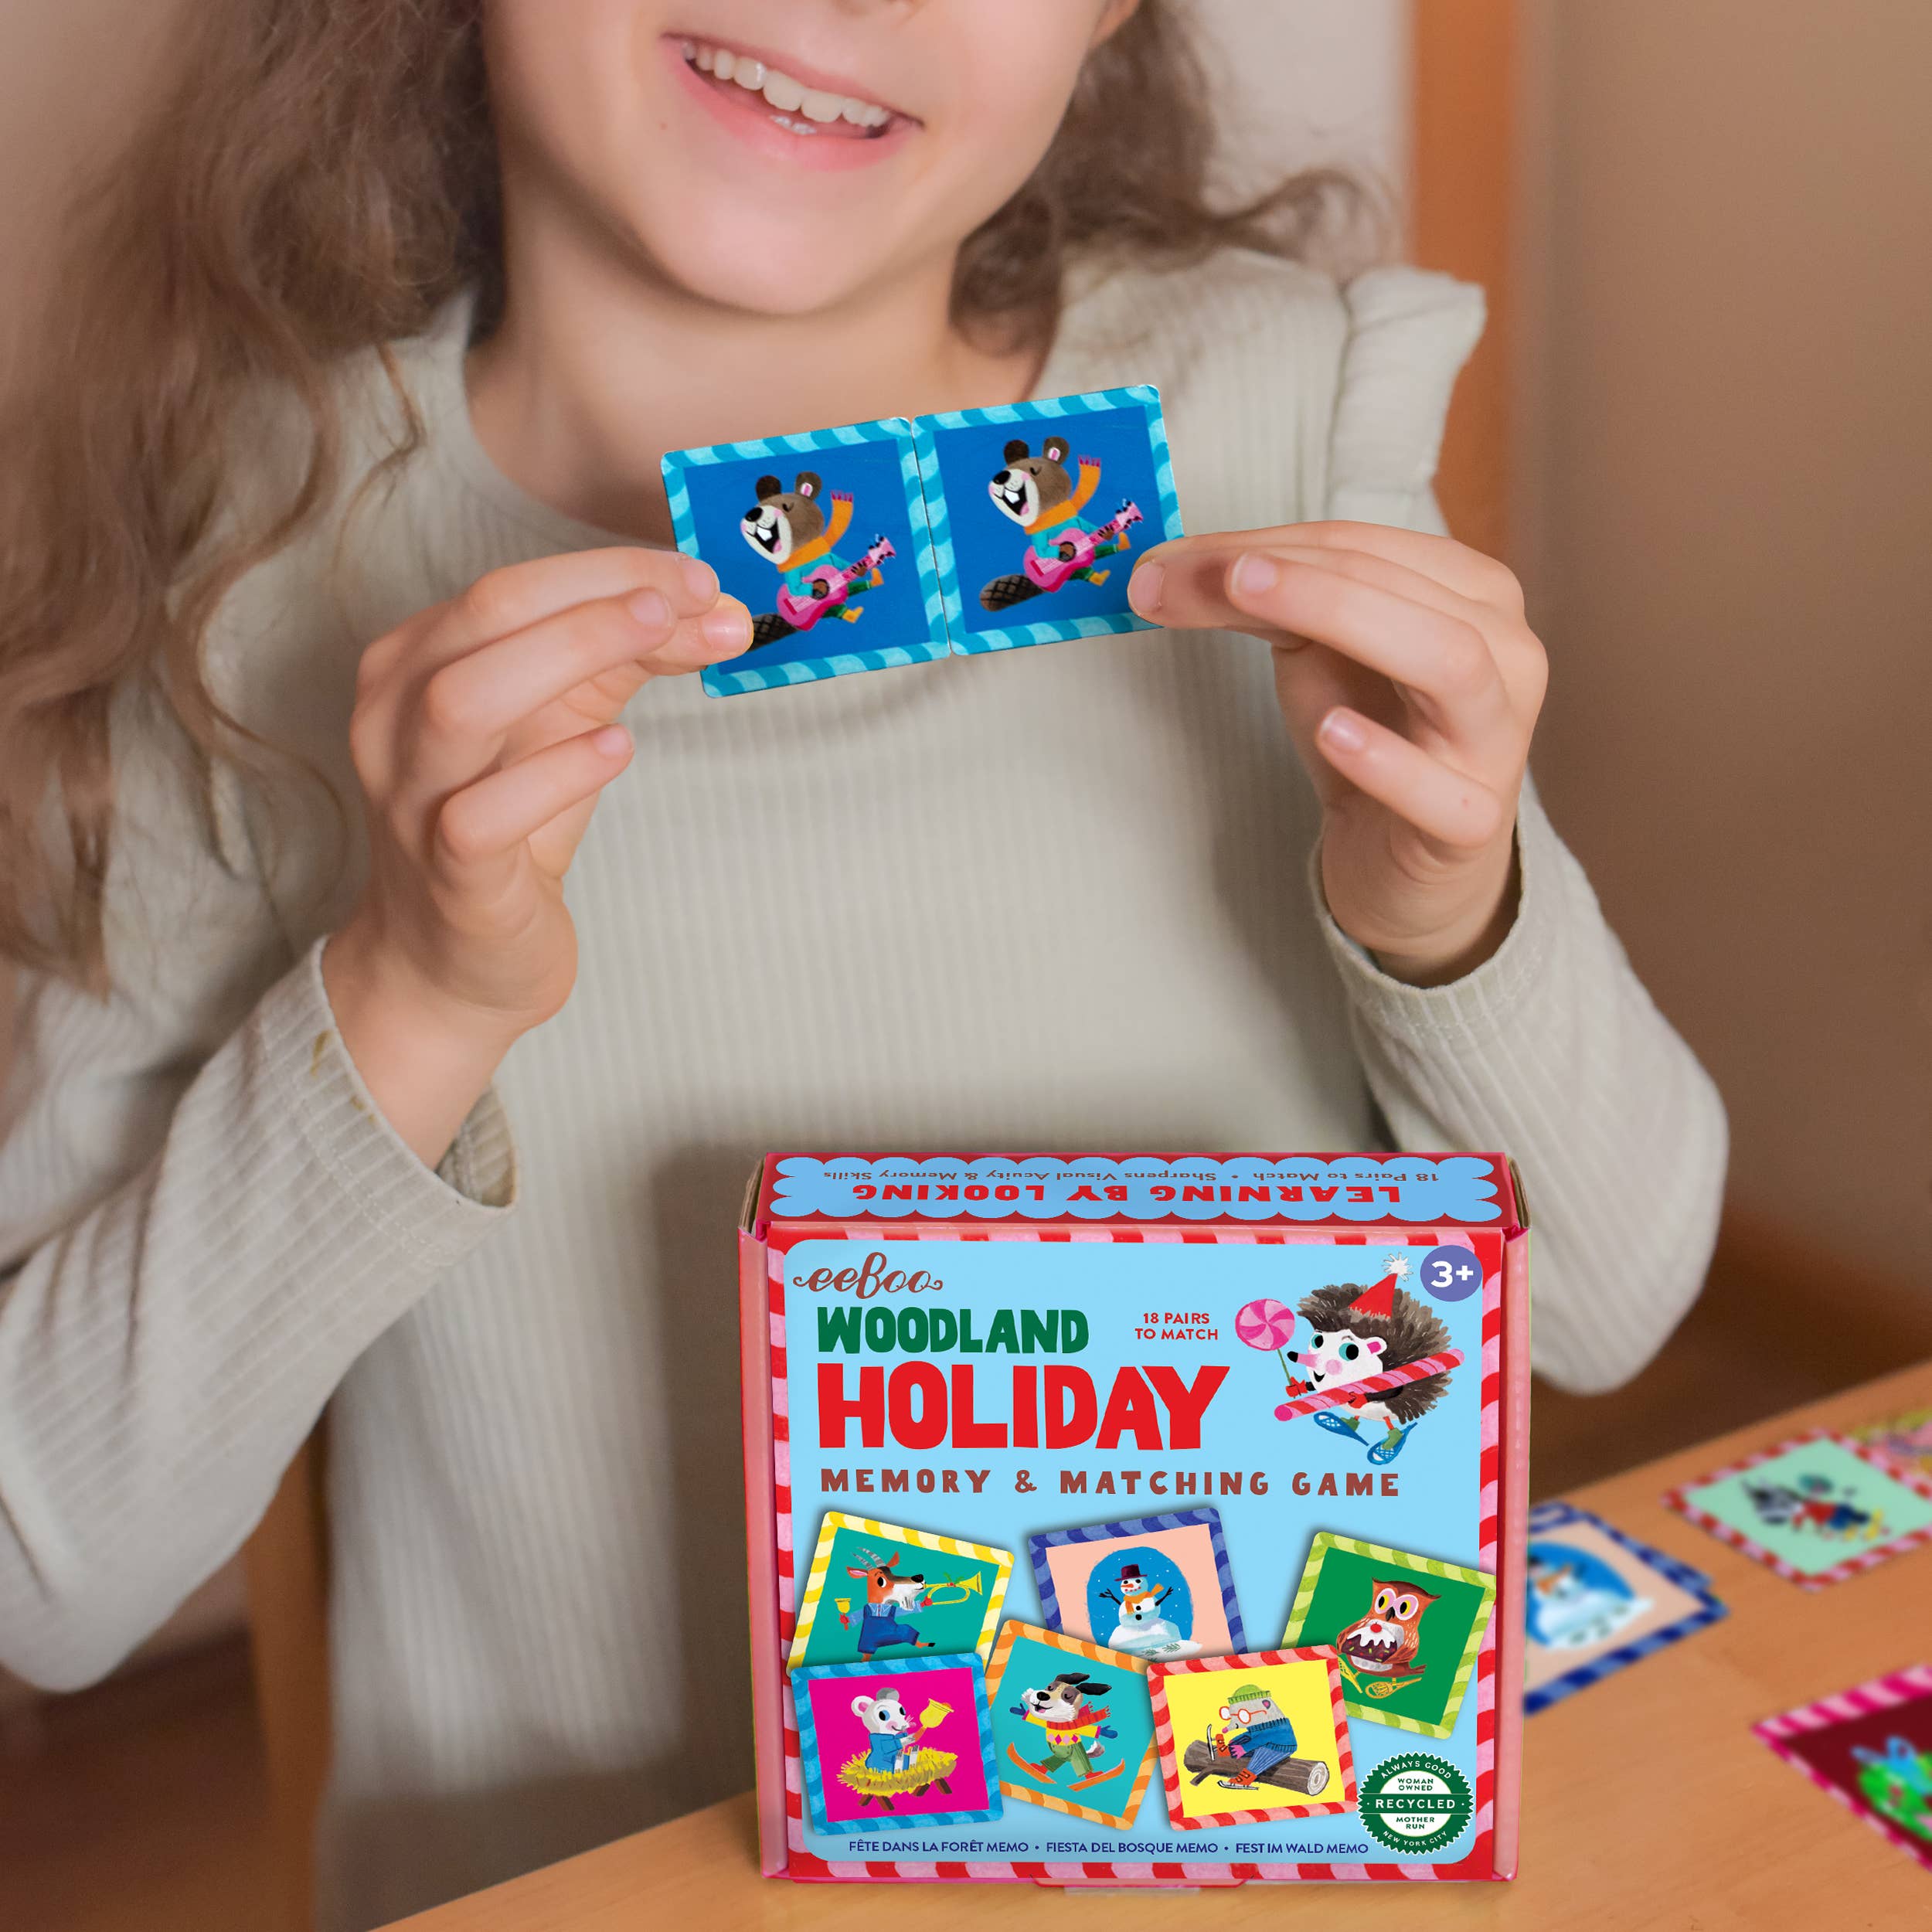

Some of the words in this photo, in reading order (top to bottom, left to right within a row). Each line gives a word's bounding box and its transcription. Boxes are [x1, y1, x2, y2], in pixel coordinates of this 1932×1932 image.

[823, 1171, 872, 1180] Skills
[879, 1169, 957, 1180] Memory
[965, 1172, 978, 1180] &
[986, 1169, 1050, 1180] Acuity
[1057, 1172, 1117, 1181] Visual
[1124, 1170, 1216, 1181] Sharpens
[1253, 1172, 1319, 1181] Match
[1355, 1172, 1406, 1181] Pairs
[1415, 1173, 1439, 1182] 18
[852, 1184, 1044, 1201] LOOKING
[1066, 1185, 1128, 1201] BY
[1150, 1185, 1400, 1202] LEARNING
[1430, 1260, 1474, 1288] 3+
[1143, 1312, 1159, 1325] 18
[1164, 1312, 1210, 1325] PAIRS
[817, 1306, 1090, 1354] WOODLAND
[1134, 1328, 1157, 1340] TO
[1161, 1328, 1219, 1341] MATCH
[817, 1360, 1230, 1451] HOLIDAY
[820, 1468, 991, 1493] MEMORY
[1014, 1470, 1037, 1492] &
[1060, 1470, 1269, 1496] MATCHING
[1292, 1472, 1399, 1497] GAME
[1380, 1760, 1420, 1779] ALWAYS
[1425, 1762, 1452, 1779] GOOD
[1376, 1799, 1455, 1809] RECYCLED
[1383, 1830, 1400, 1843] NEW
[1430, 1831, 1447, 1844] CITY
[849, 1839, 879, 1852] FÊTE
[883, 1842, 920, 1852] DANS
[922, 1842, 938, 1852] LA
[941, 1839, 984, 1852] FORÊT
[986, 1842, 1029, 1852] MEMO
[1046, 1842, 1088, 1852] FIESTA
[1091, 1842, 1115, 1852] DEL
[1118, 1842, 1173, 1855] BOSQUE
[1176, 1842, 1219, 1853] MEMO
[1236, 1843, 1265, 1853] FEST
[1267, 1843, 1284, 1853] IM
[1285, 1843, 1324, 1853] WALD
[1326, 1843, 1369, 1854] MEMO
